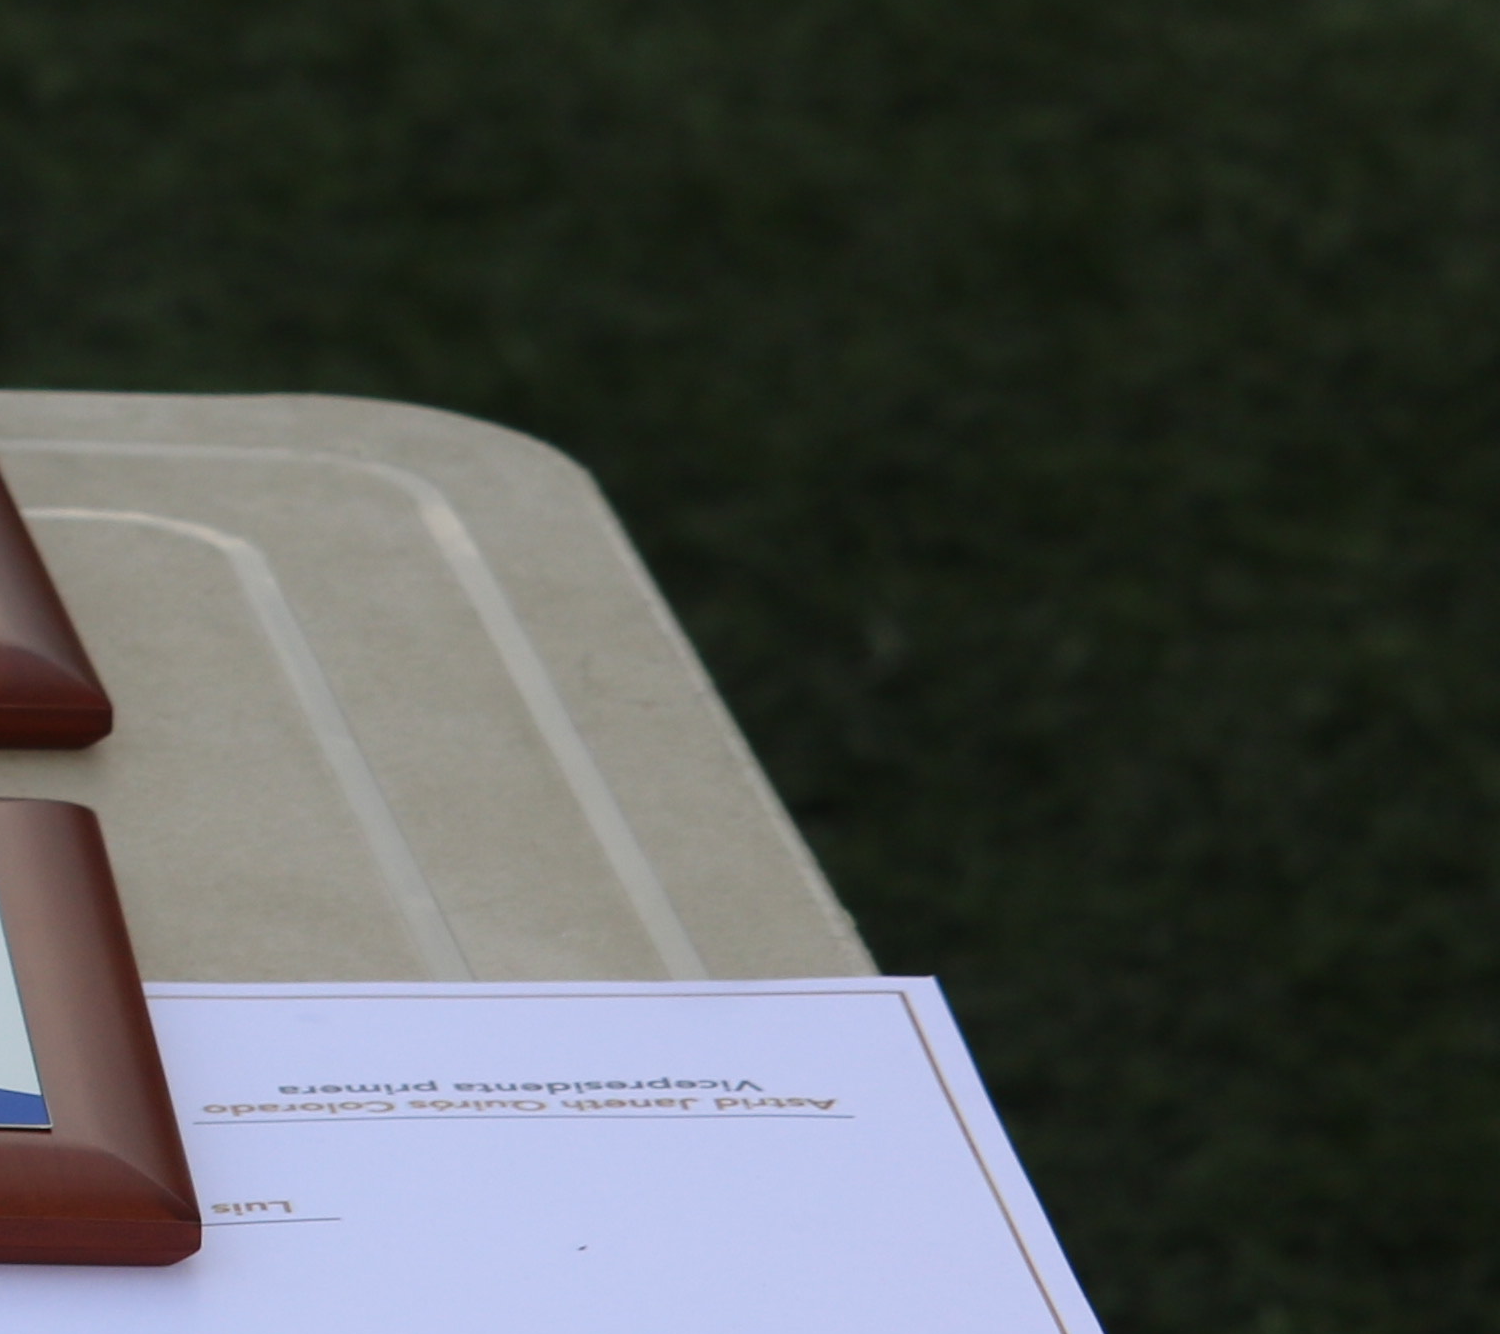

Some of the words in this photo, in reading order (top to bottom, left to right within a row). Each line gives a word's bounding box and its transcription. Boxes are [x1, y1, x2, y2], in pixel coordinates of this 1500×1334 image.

[278, 1080, 439, 1096] primera
[452, 1077, 765, 1095] Vicepresidenta
[202, 1100, 396, 1117] Colorado
[407, 1099, 547, 1112] Quirós
[560, 1097, 700, 1112] Janeth
[713, 1097, 837, 1111] Astrid
[211, 1200, 292, 1216] Luis
